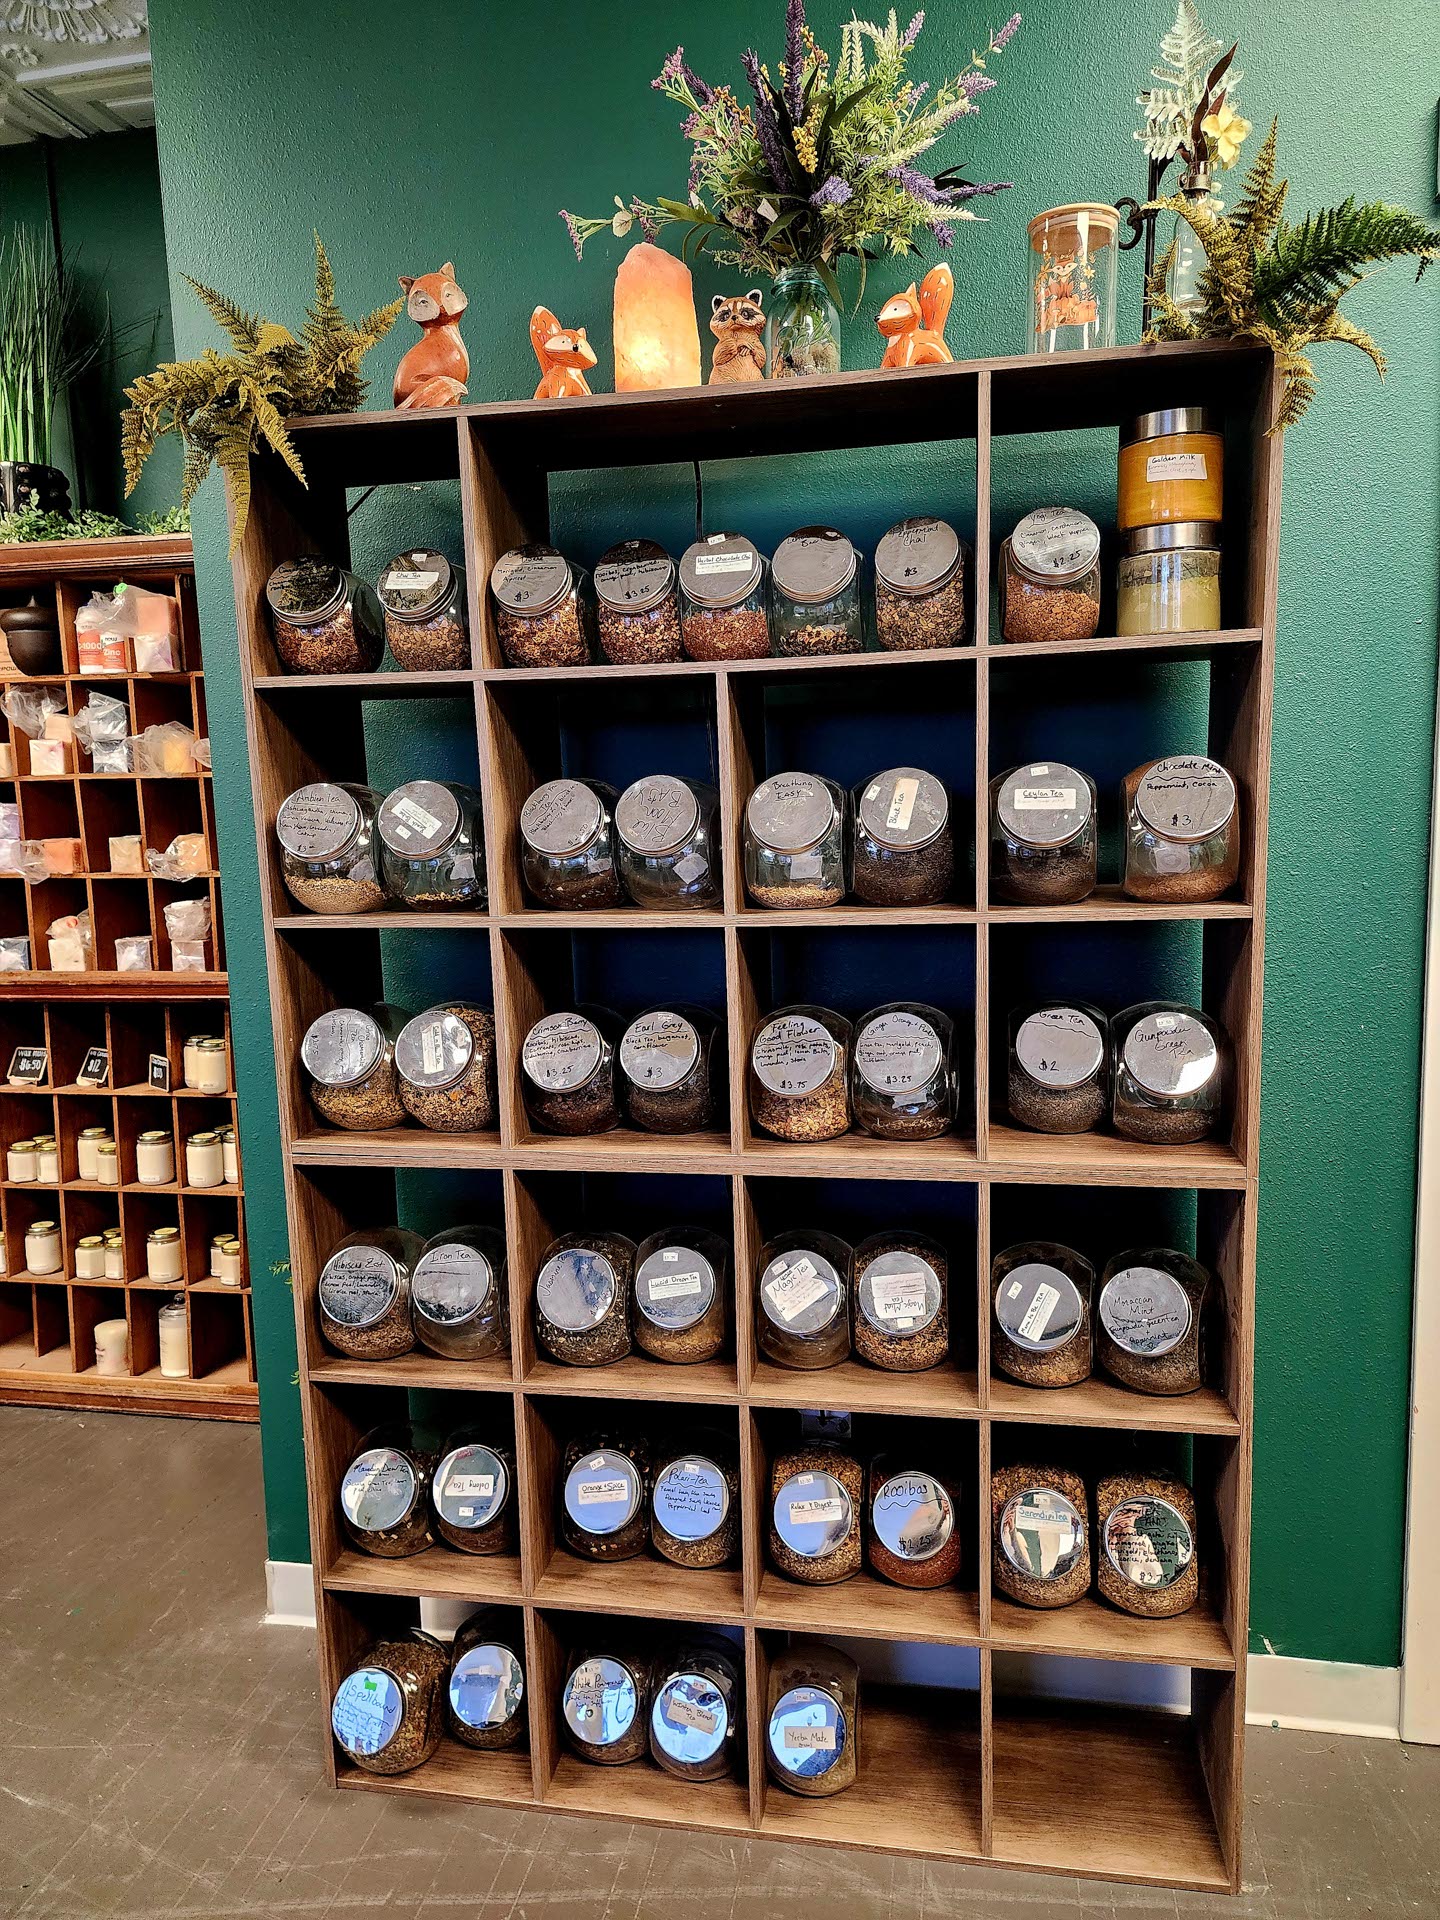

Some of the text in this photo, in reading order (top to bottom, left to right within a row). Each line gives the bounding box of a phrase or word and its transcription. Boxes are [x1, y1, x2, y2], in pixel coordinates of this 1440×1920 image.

[1151, 455, 1176, 463] Golden
[104, 648, 121, 656] Zinc
[1039, 1010, 1086, 1026] Green Tea
[635, 1020, 684, 1034] Earl Grey
[773, 1021, 805, 1034] Feeling
[760, 1026, 822, 1044] Good Flower
[784, 1080, 808, 1090] $3.75
[889, 1075, 913, 1085] $3.25
[456, 1250, 472, 1259] Tea
[448, 1479, 465, 1492] Tea
[810, 1731, 829, 1743] Mate
